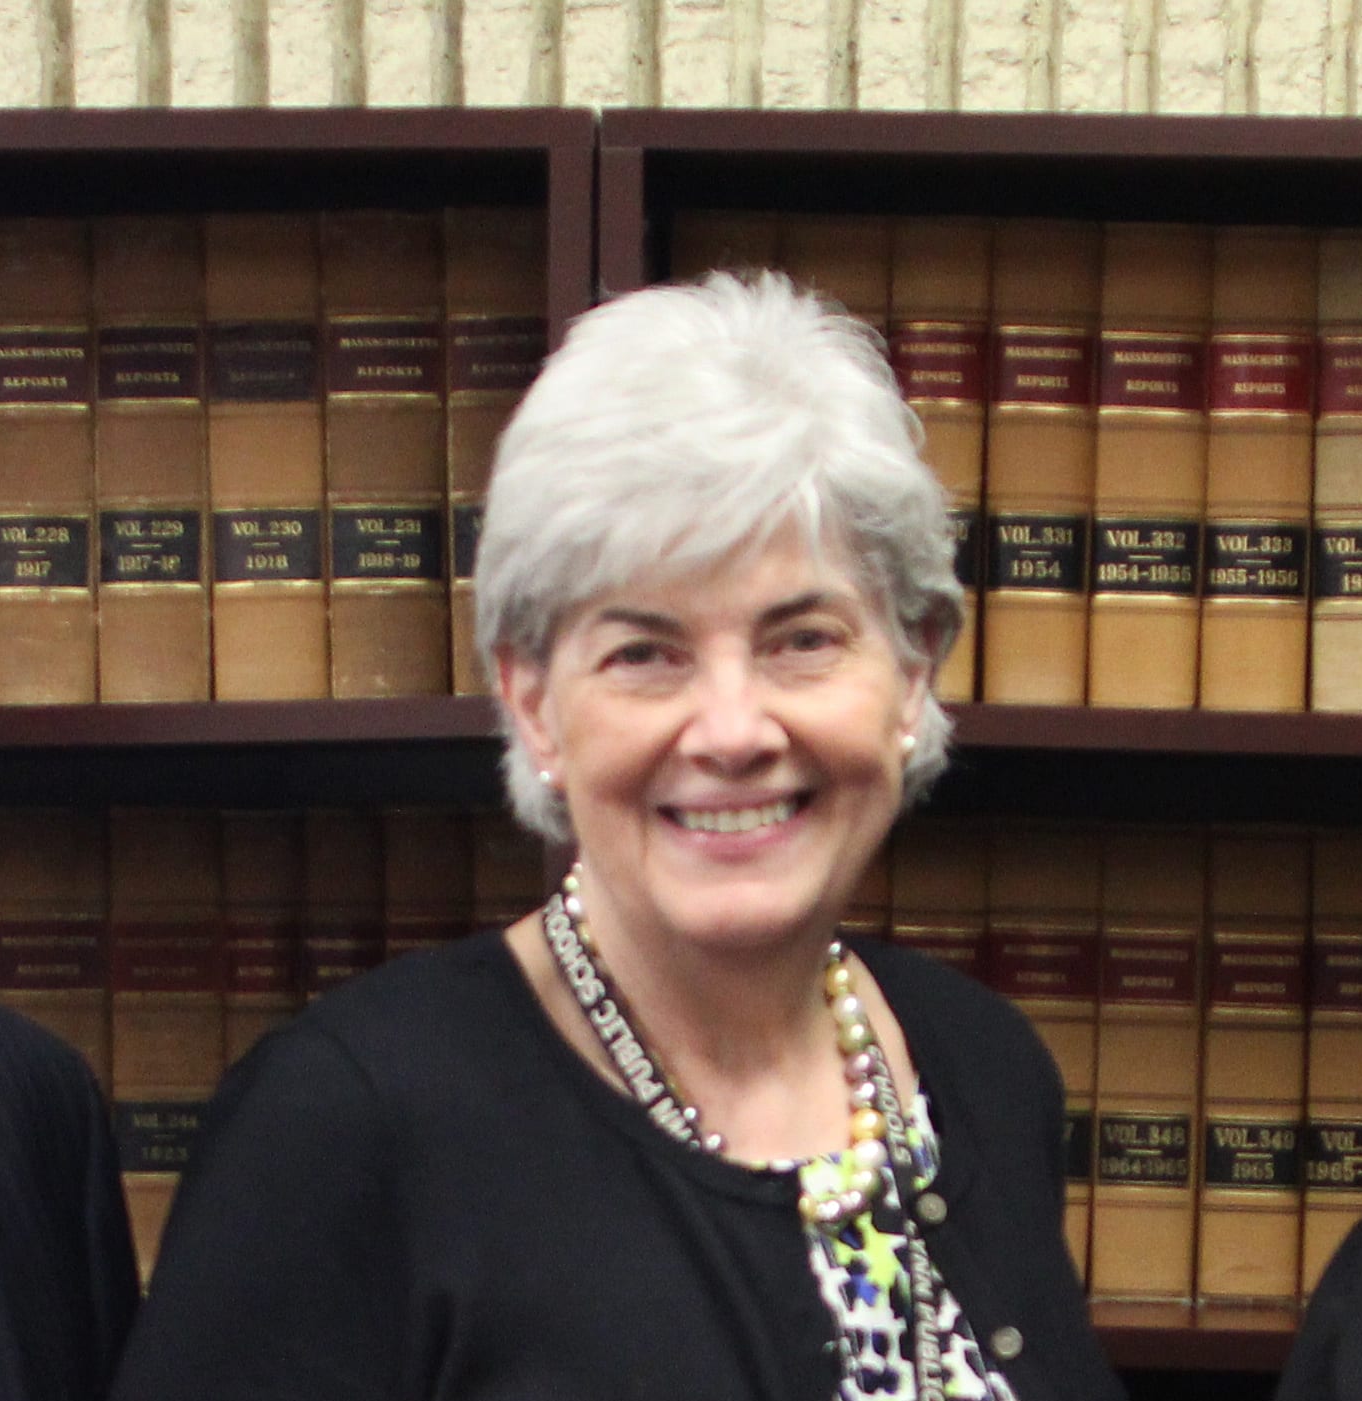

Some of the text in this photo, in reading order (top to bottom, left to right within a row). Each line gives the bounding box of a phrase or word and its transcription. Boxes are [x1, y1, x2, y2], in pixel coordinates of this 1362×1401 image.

[115, 371, 181, 384] REPORTS
[357, 365, 422, 378] REPORTS
[3, 376, 68, 389] REPORTS
[1016, 374, 1070, 389] REPORTS
[1125, 379, 1179, 394] REPORTS
[1233, 382, 1287, 396] REPORTS
[998, 525, 1074, 546] VOL.331
[1106, 529, 1186, 550] VOL.332
[1217, 534, 1293, 554] VOL.333
[14, 560, 52, 577] 1917
[244, 554, 288, 571] 1918
[1009, 559, 1063, 580] 1954
[1097, 563, 1192, 585] 1954-1955
[1209, 567, 1299, 587] 1955-1956
[589, 998, 666, 1105] PUBLIC
[1231, 1162, 1274, 1181] 1965
